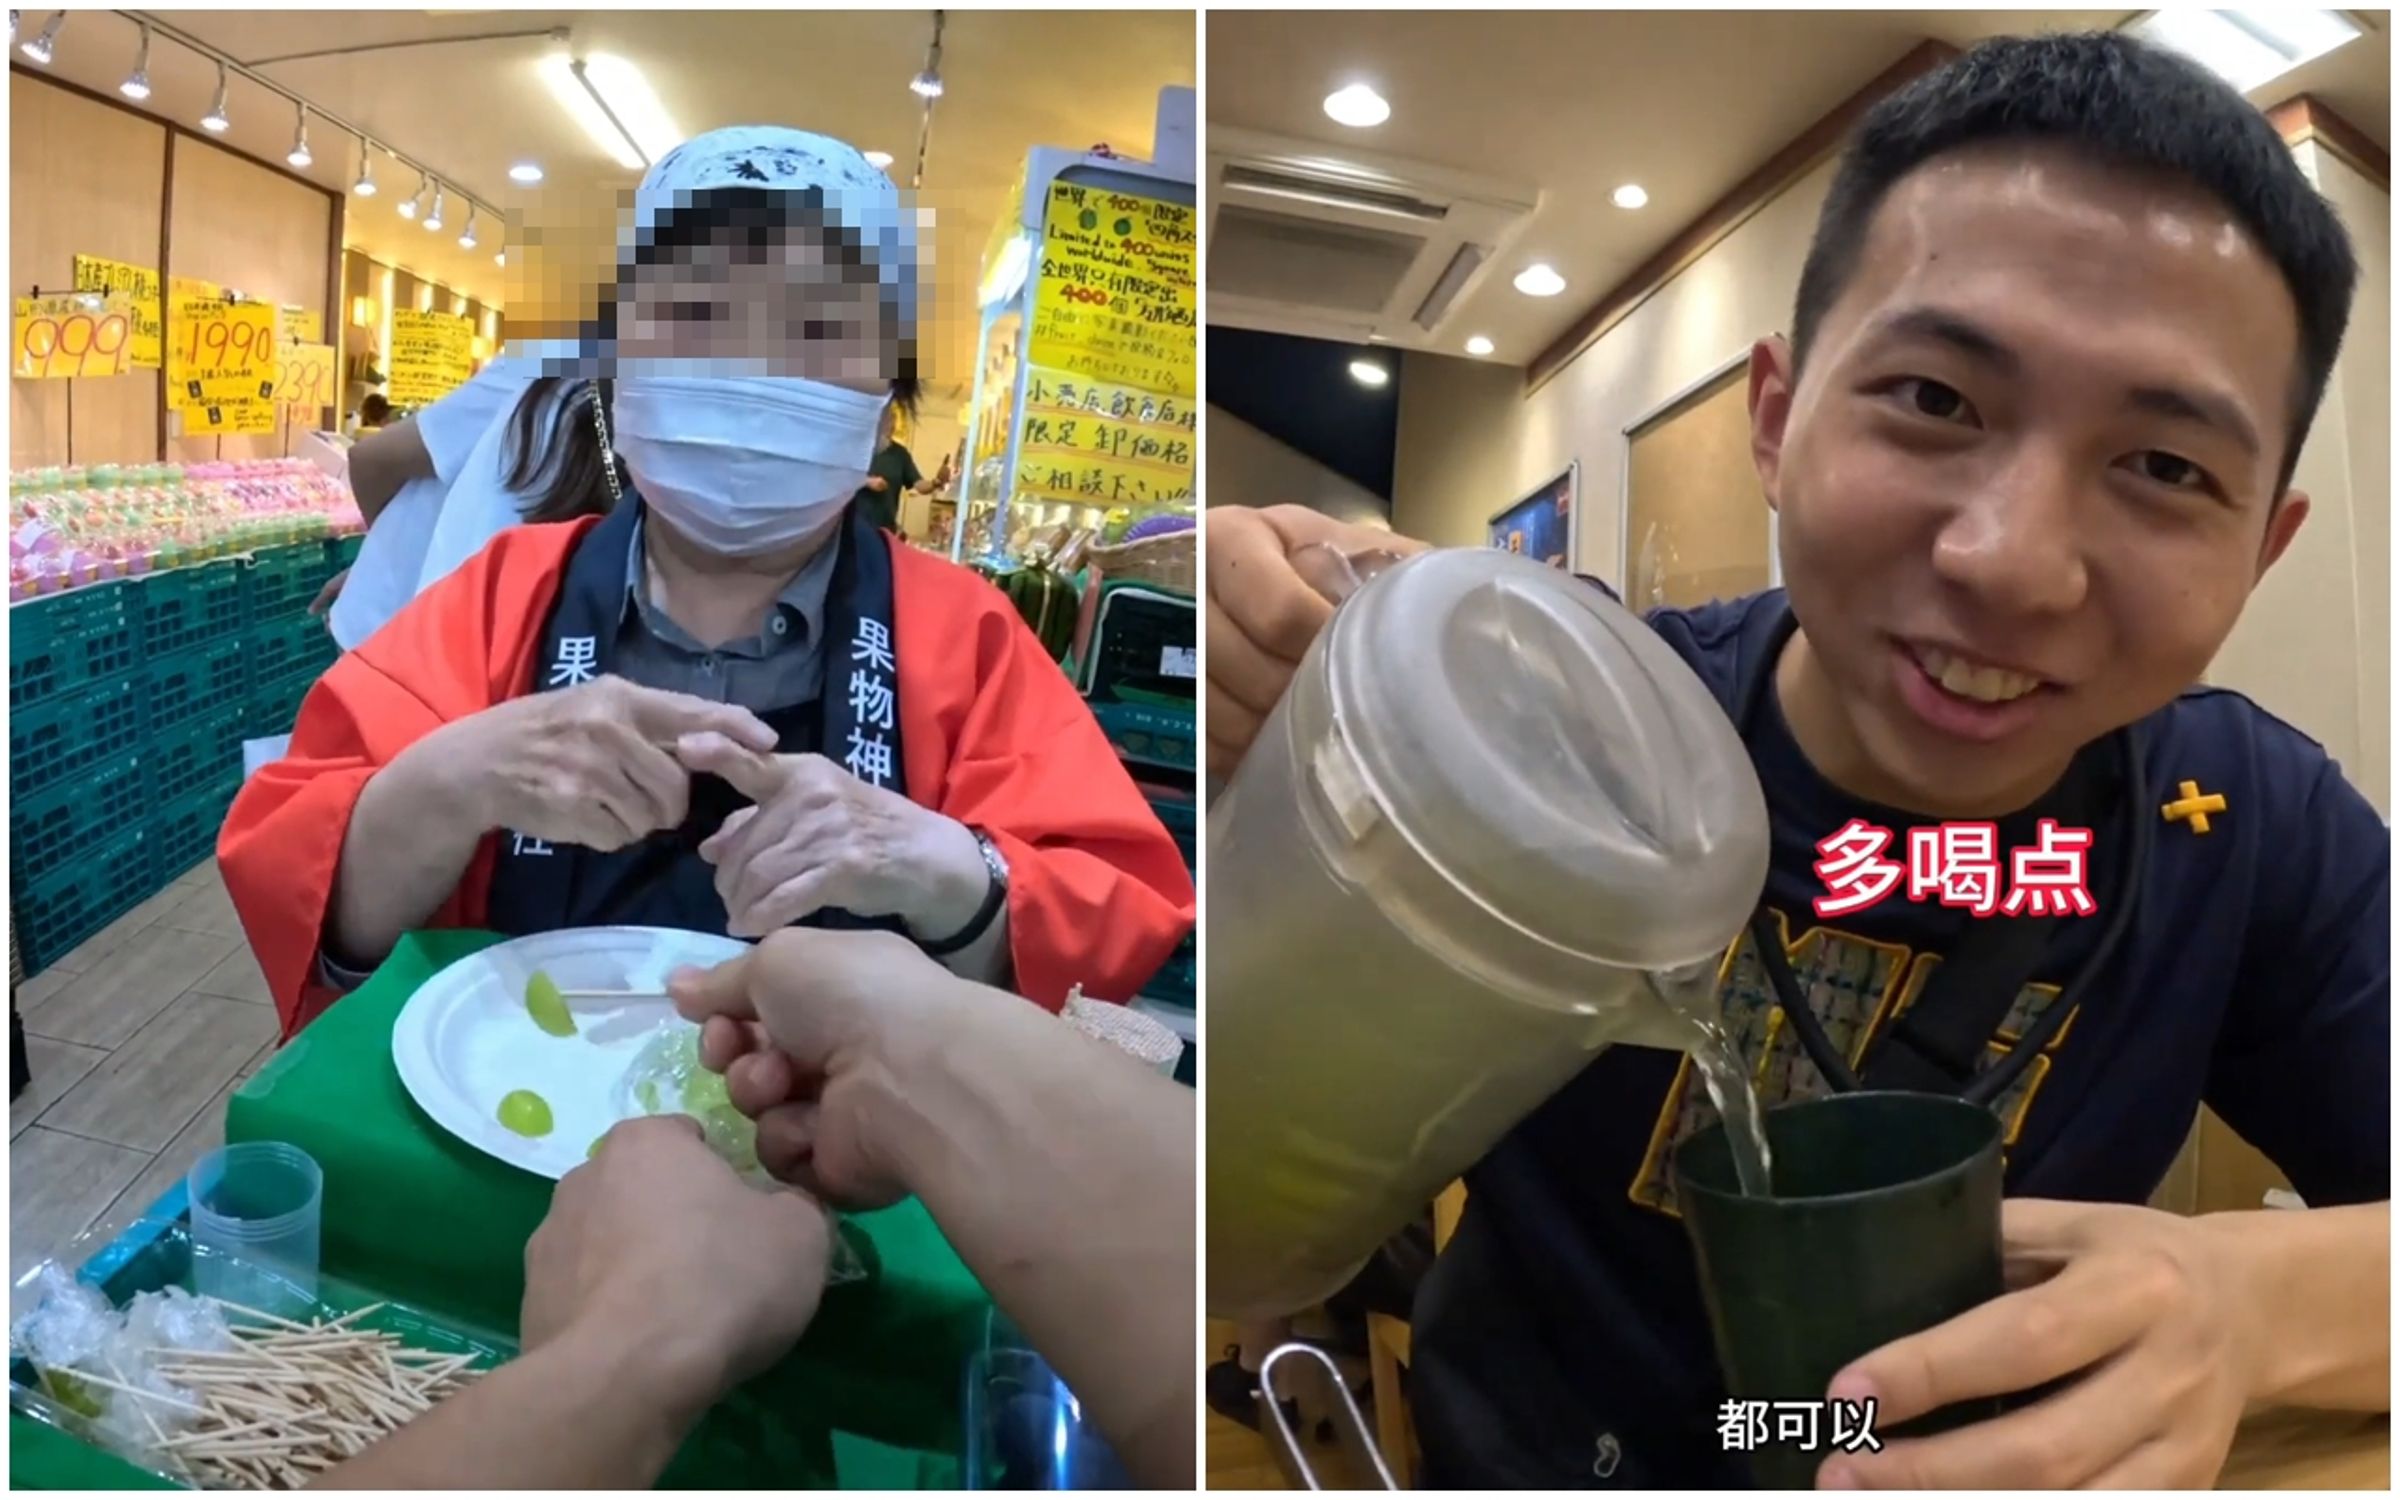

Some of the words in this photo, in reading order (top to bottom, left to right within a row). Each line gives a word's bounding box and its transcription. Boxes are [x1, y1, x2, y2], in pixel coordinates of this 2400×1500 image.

[1050, 223, 1101, 248] Limited
[1120, 237, 1154, 256] 400
[24, 314, 128, 378] 999
[190, 321, 271, 367] 1990
[1025, 418, 1078, 447] 限定
[1095, 424, 1189, 465] 卸価格
